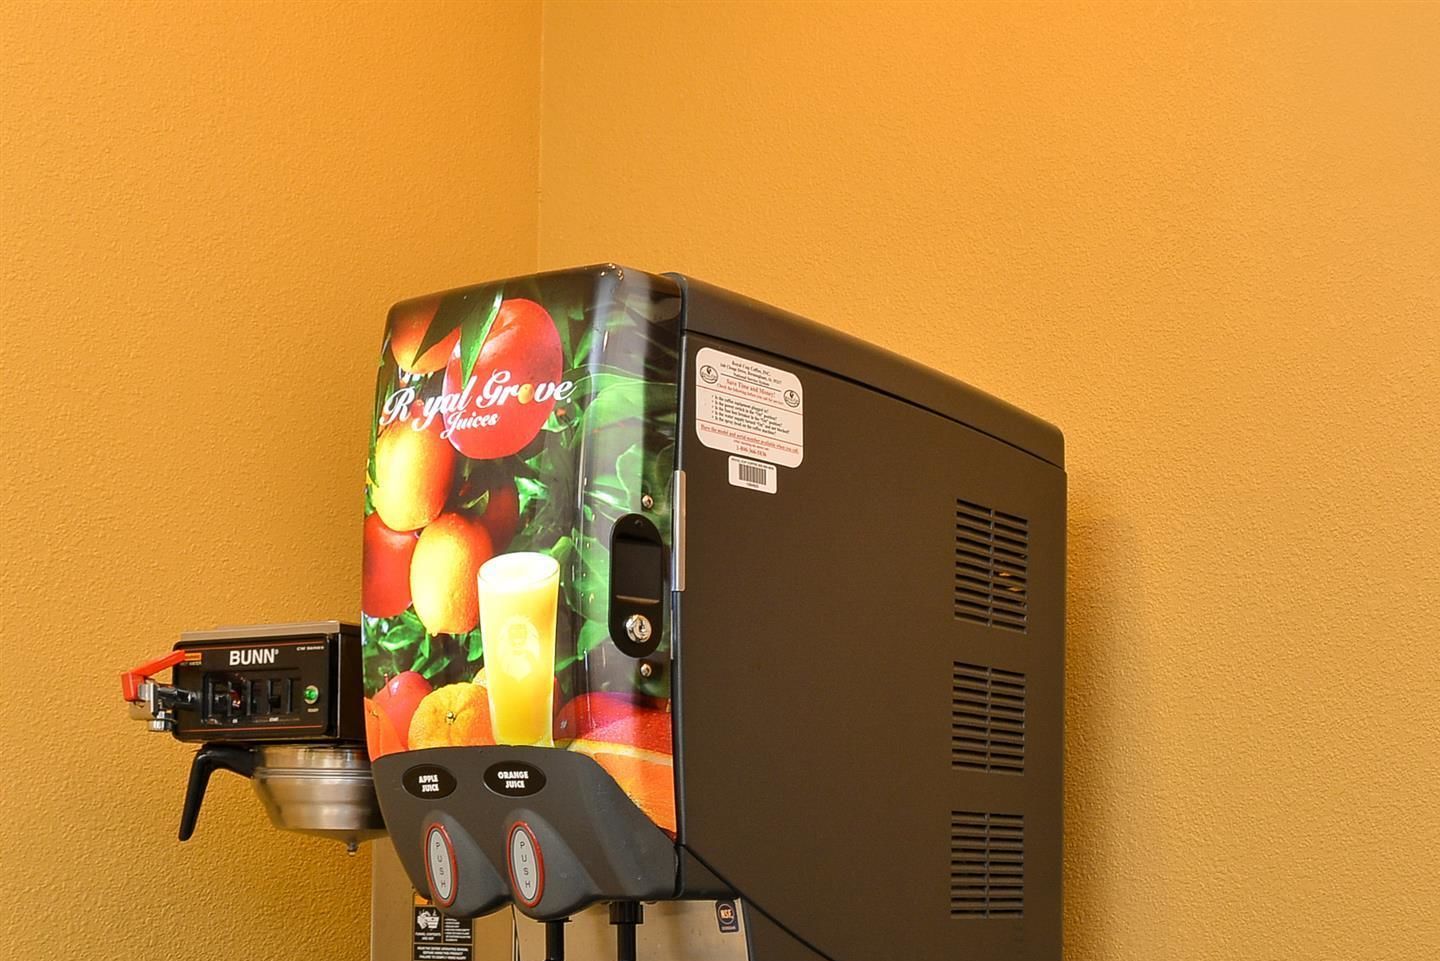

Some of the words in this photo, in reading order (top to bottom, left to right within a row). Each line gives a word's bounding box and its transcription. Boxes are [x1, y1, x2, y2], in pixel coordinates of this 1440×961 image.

[440, 411, 499, 439] Juices
[418, 774, 439, 784] APPLE
[497, 771, 529, 780] ORANGE
[421, 783, 440, 792] JUICE
[505, 780, 526, 789] JUICE
[434, 841, 447, 888] PUSH
[519, 841, 531, 888] PUSH
